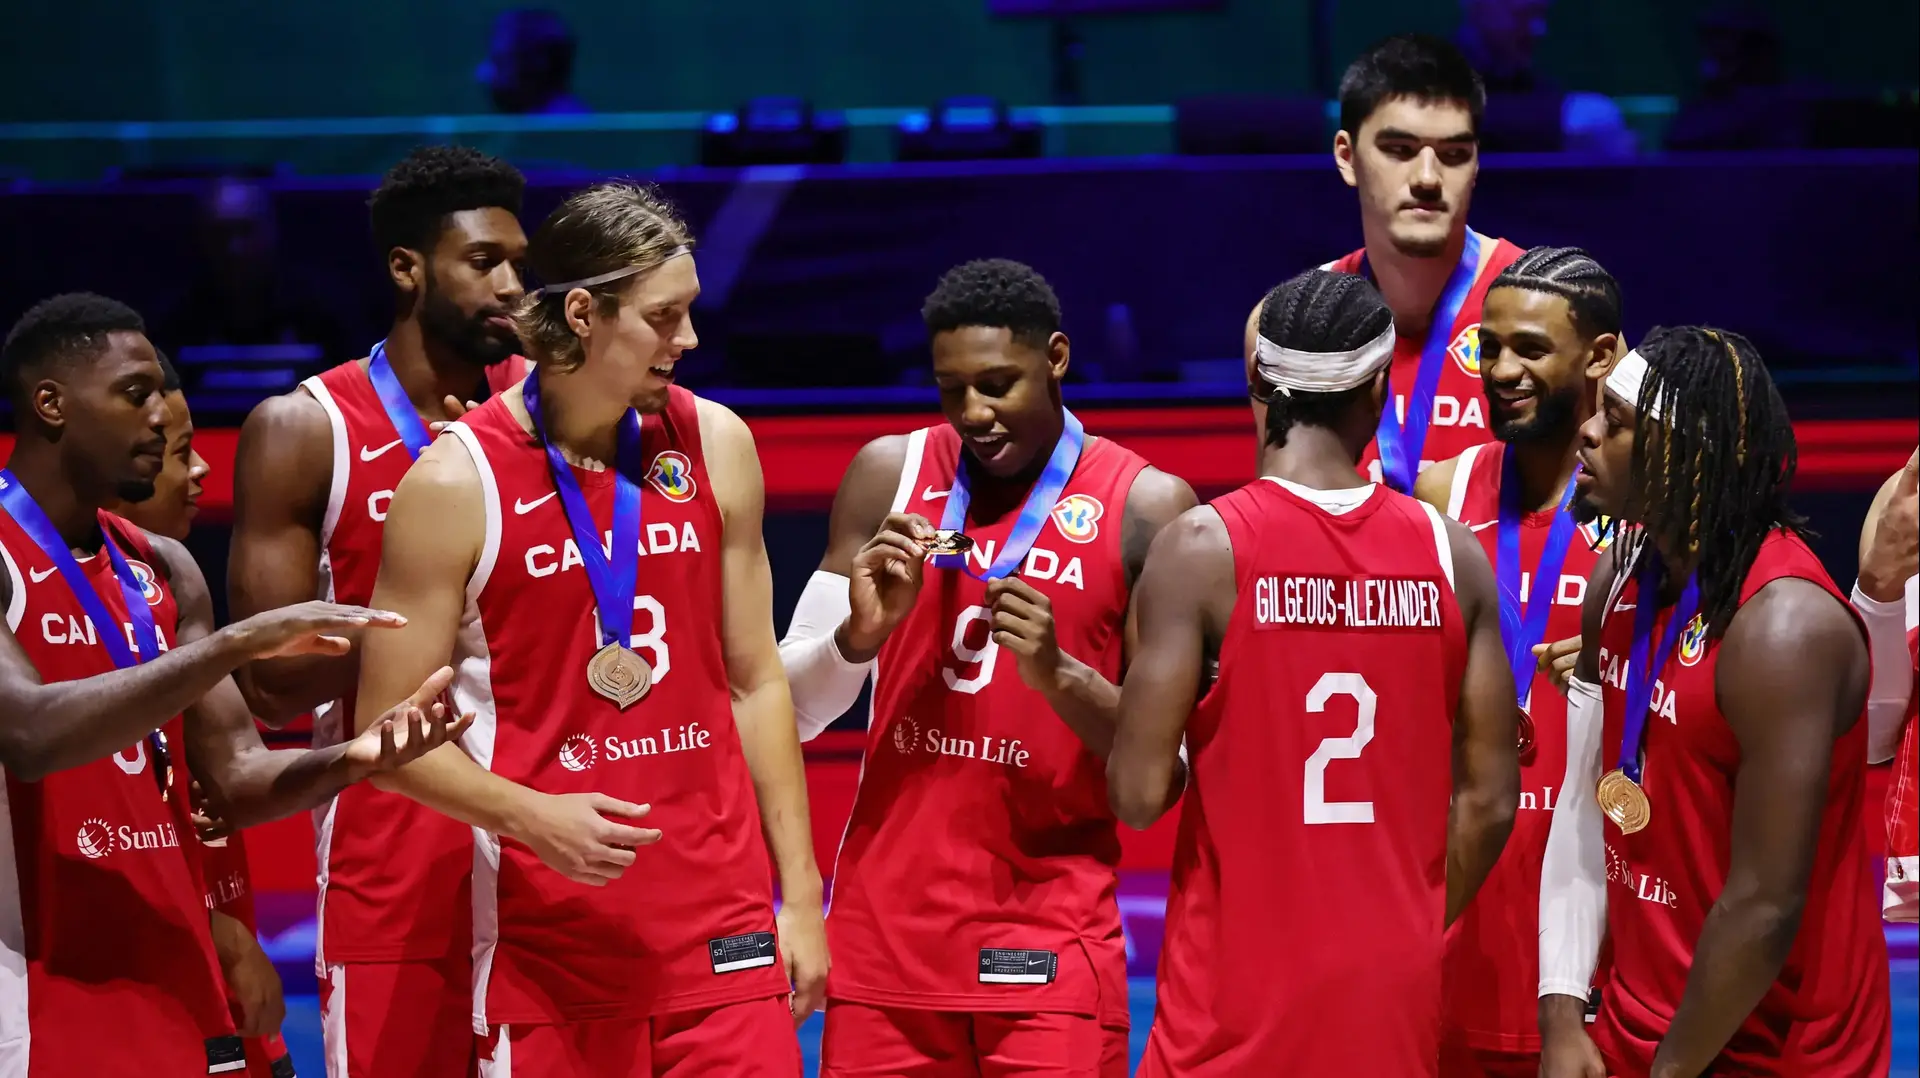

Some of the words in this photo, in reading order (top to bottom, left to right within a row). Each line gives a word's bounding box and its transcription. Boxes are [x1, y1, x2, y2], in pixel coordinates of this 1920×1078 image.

[524, 521, 702, 579] CADA
[1255, 576, 1441, 627] GILGEOUS-ALEXANDER
[592, 594, 671, 685] 3
[942, 604, 1000, 695] 9
[604, 736, 659, 762] Sun
[660, 721, 712, 754] Life
[925, 728, 976, 758] Sun
[980, 736, 1030, 768] Life
[1303, 672, 1378, 825] 2
[117, 825, 160, 851] Sun
[1621, 859, 1637, 892] Su
[1637, 873, 1678, 909] Life
[713, 948, 724, 957] 52
[981, 958, 991, 966] 50
